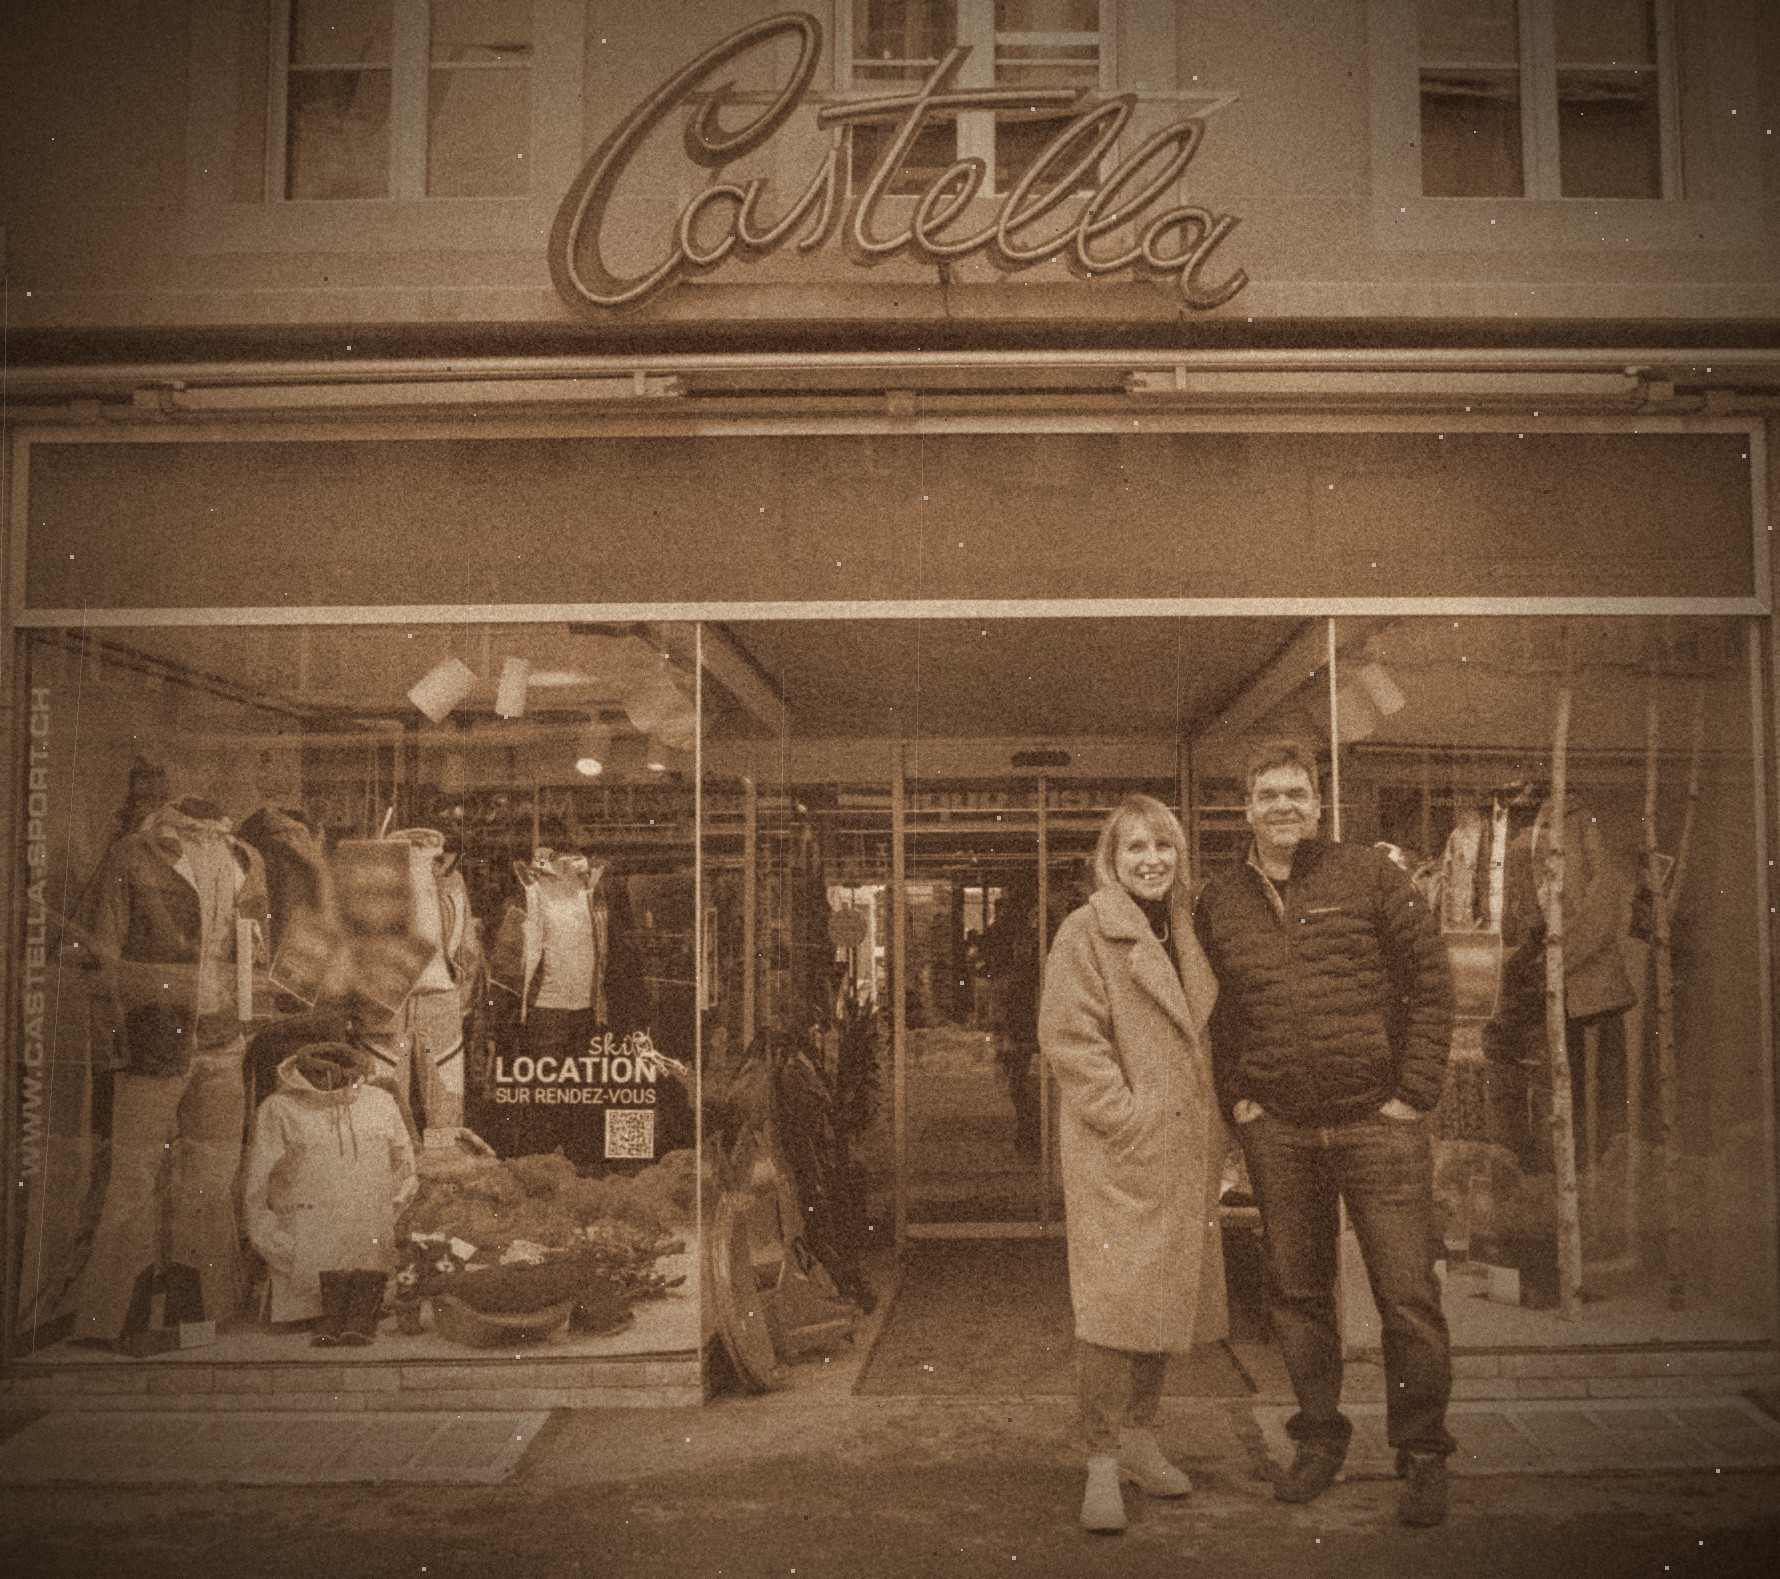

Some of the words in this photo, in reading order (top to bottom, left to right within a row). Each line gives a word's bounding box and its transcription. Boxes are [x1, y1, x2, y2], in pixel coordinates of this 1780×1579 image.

[549, 11, 1249, 312] Castella
[496, 1057, 656, 1083] LOCATION
[496, 1087, 530, 1104] SUR
[535, 1088, 656, 1104] RENDEZ-VOUS
